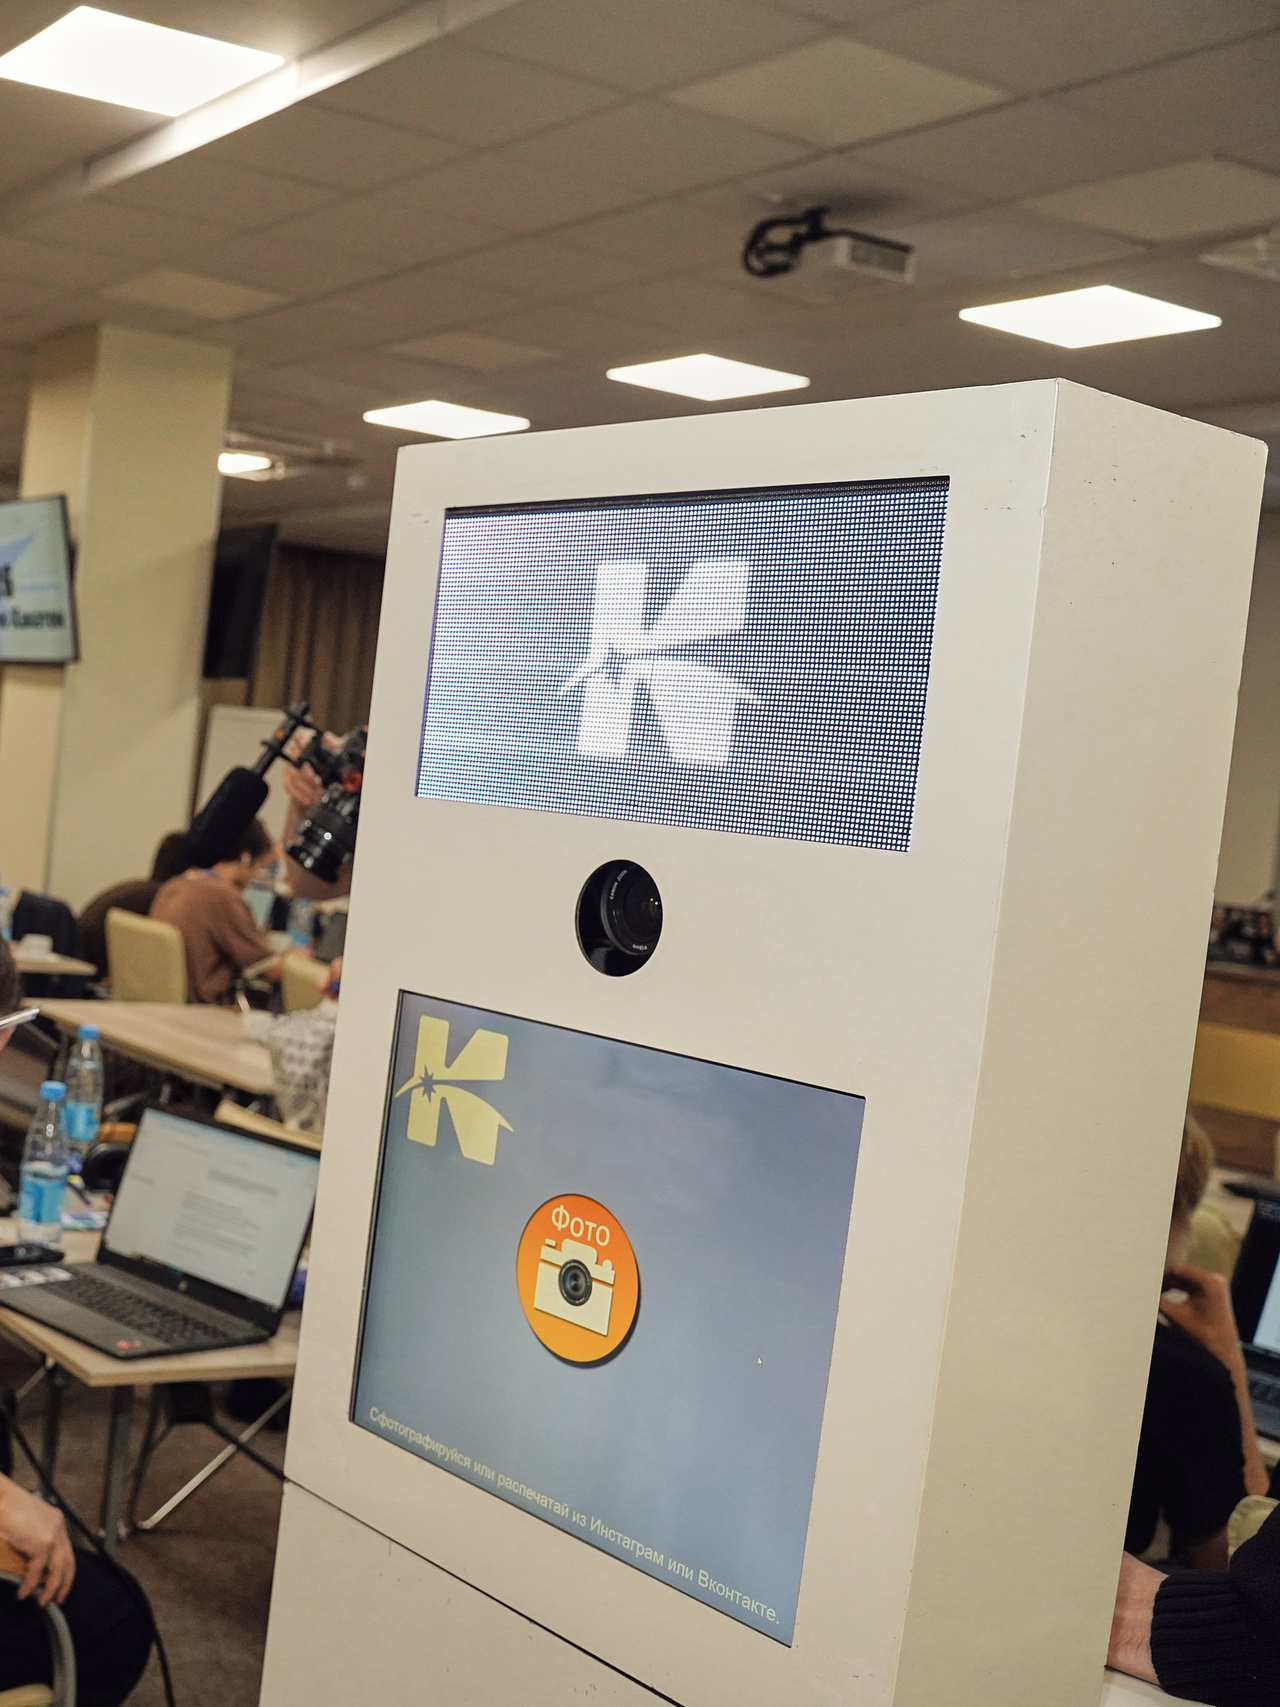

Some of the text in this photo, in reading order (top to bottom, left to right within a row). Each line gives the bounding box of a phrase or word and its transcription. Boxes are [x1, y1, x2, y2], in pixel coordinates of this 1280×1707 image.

[369, 1406, 780, 1625] Сфотографируйся или распечатай из Инстаграм или Вконтакте.
